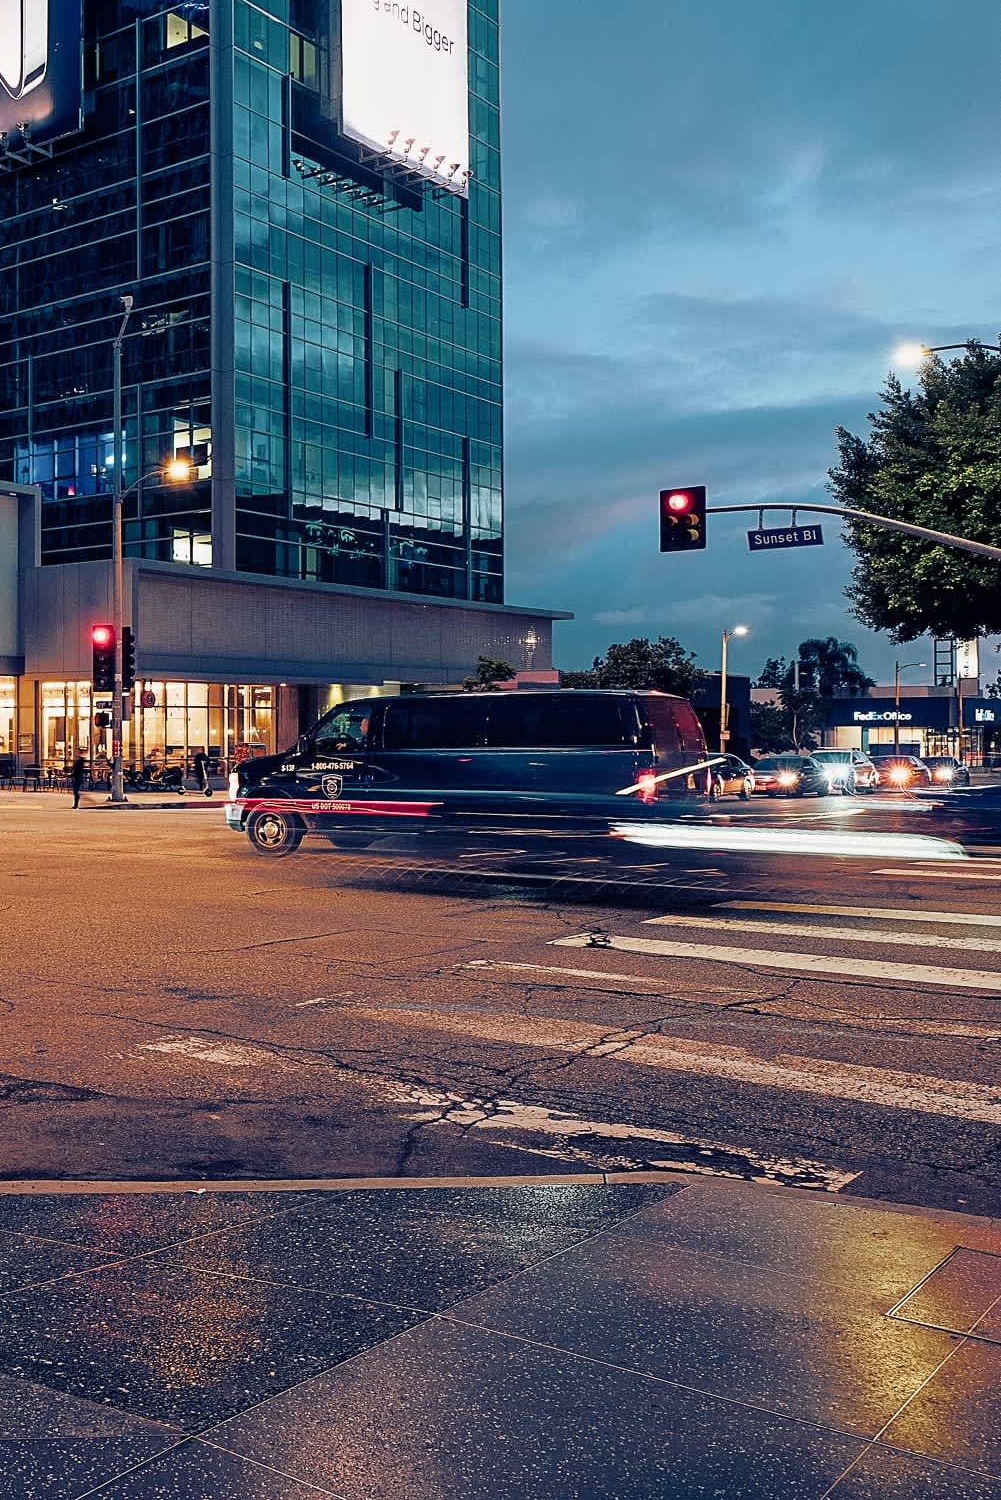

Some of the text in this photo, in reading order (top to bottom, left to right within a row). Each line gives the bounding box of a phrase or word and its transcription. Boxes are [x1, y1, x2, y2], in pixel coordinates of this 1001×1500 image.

[412, 10, 454, 55] Bigger
[754, 530, 816, 545] Sunset Bl
[853, 711, 883, 720] FedEx
[311, 802, 320, 810] US
